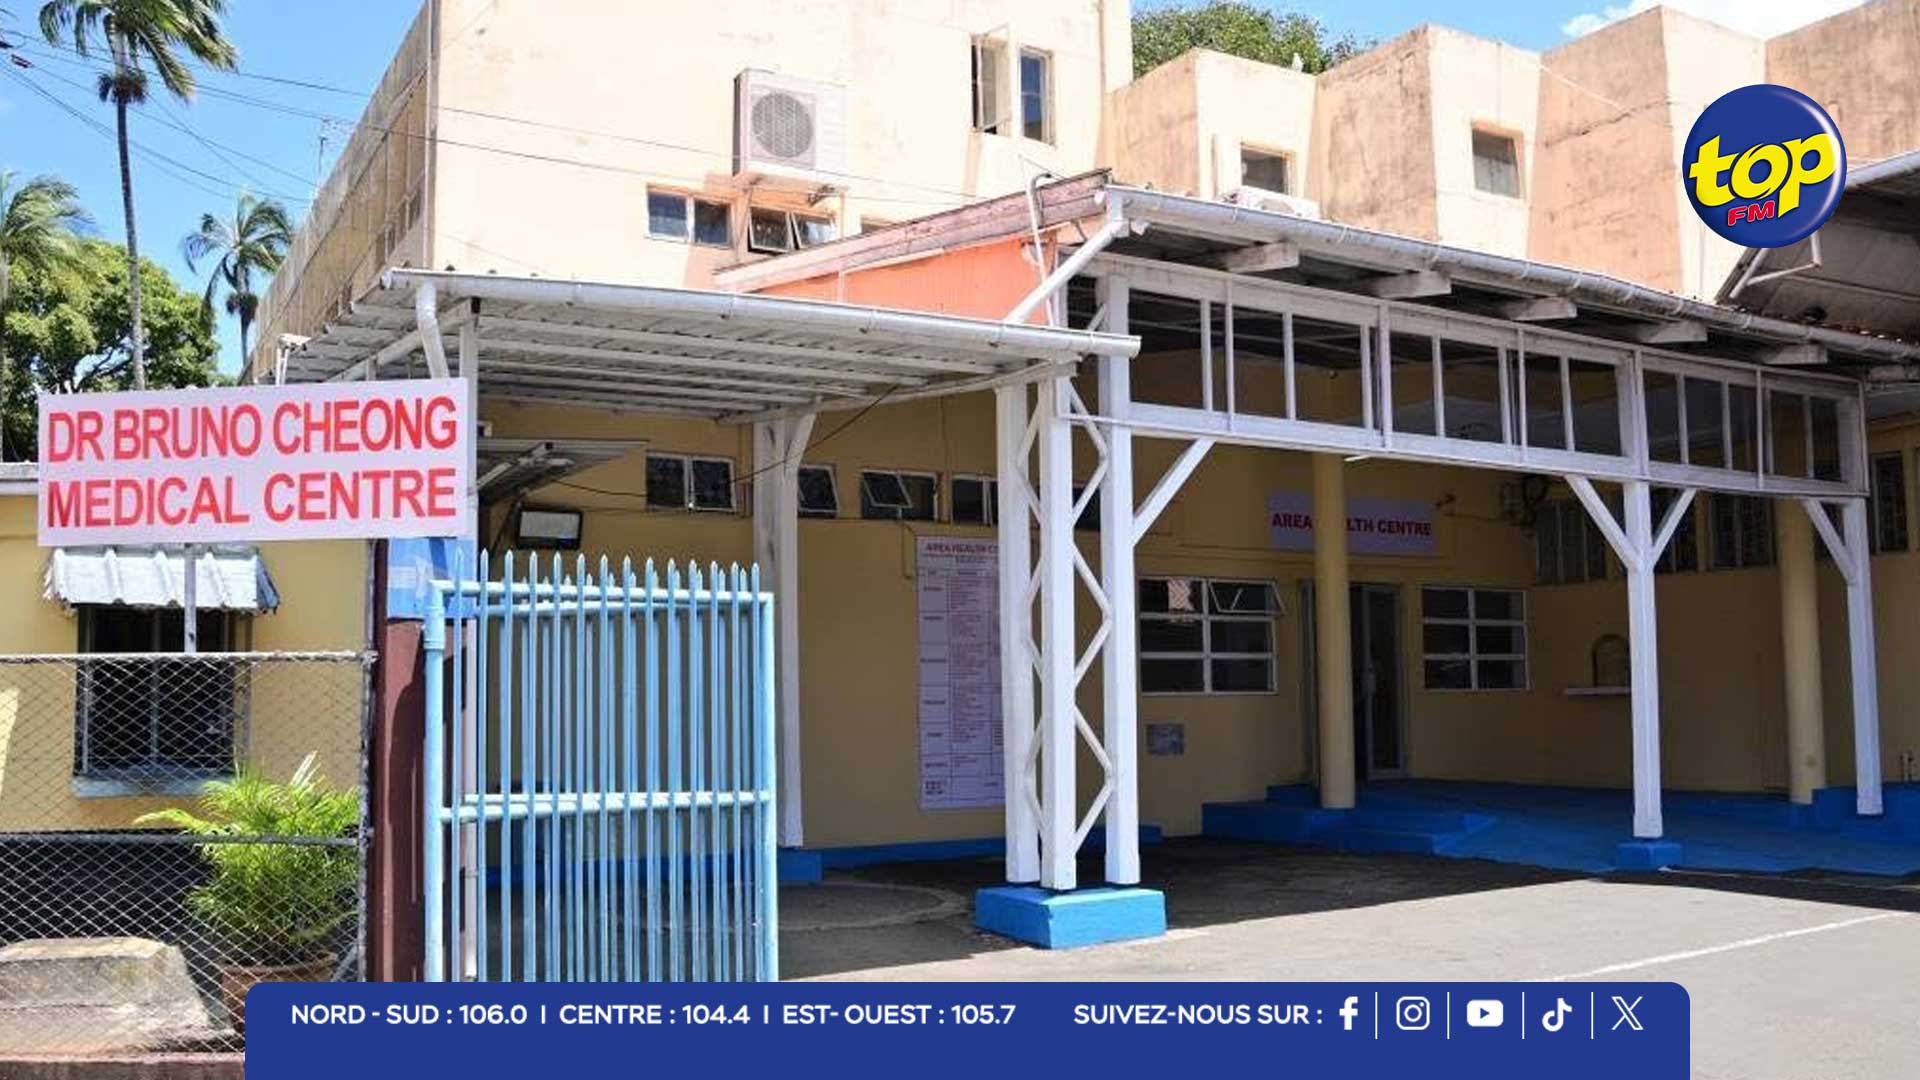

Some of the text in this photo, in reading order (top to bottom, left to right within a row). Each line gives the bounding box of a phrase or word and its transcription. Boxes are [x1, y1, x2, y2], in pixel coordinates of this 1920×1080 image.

[47, 396, 457, 463] DR BRUNO CHEONG
[47, 467, 457, 528] MEDICAL CENTRE
[1271, 512, 1313, 530] AREA
[1377, 519, 1432, 536] CENTRE
